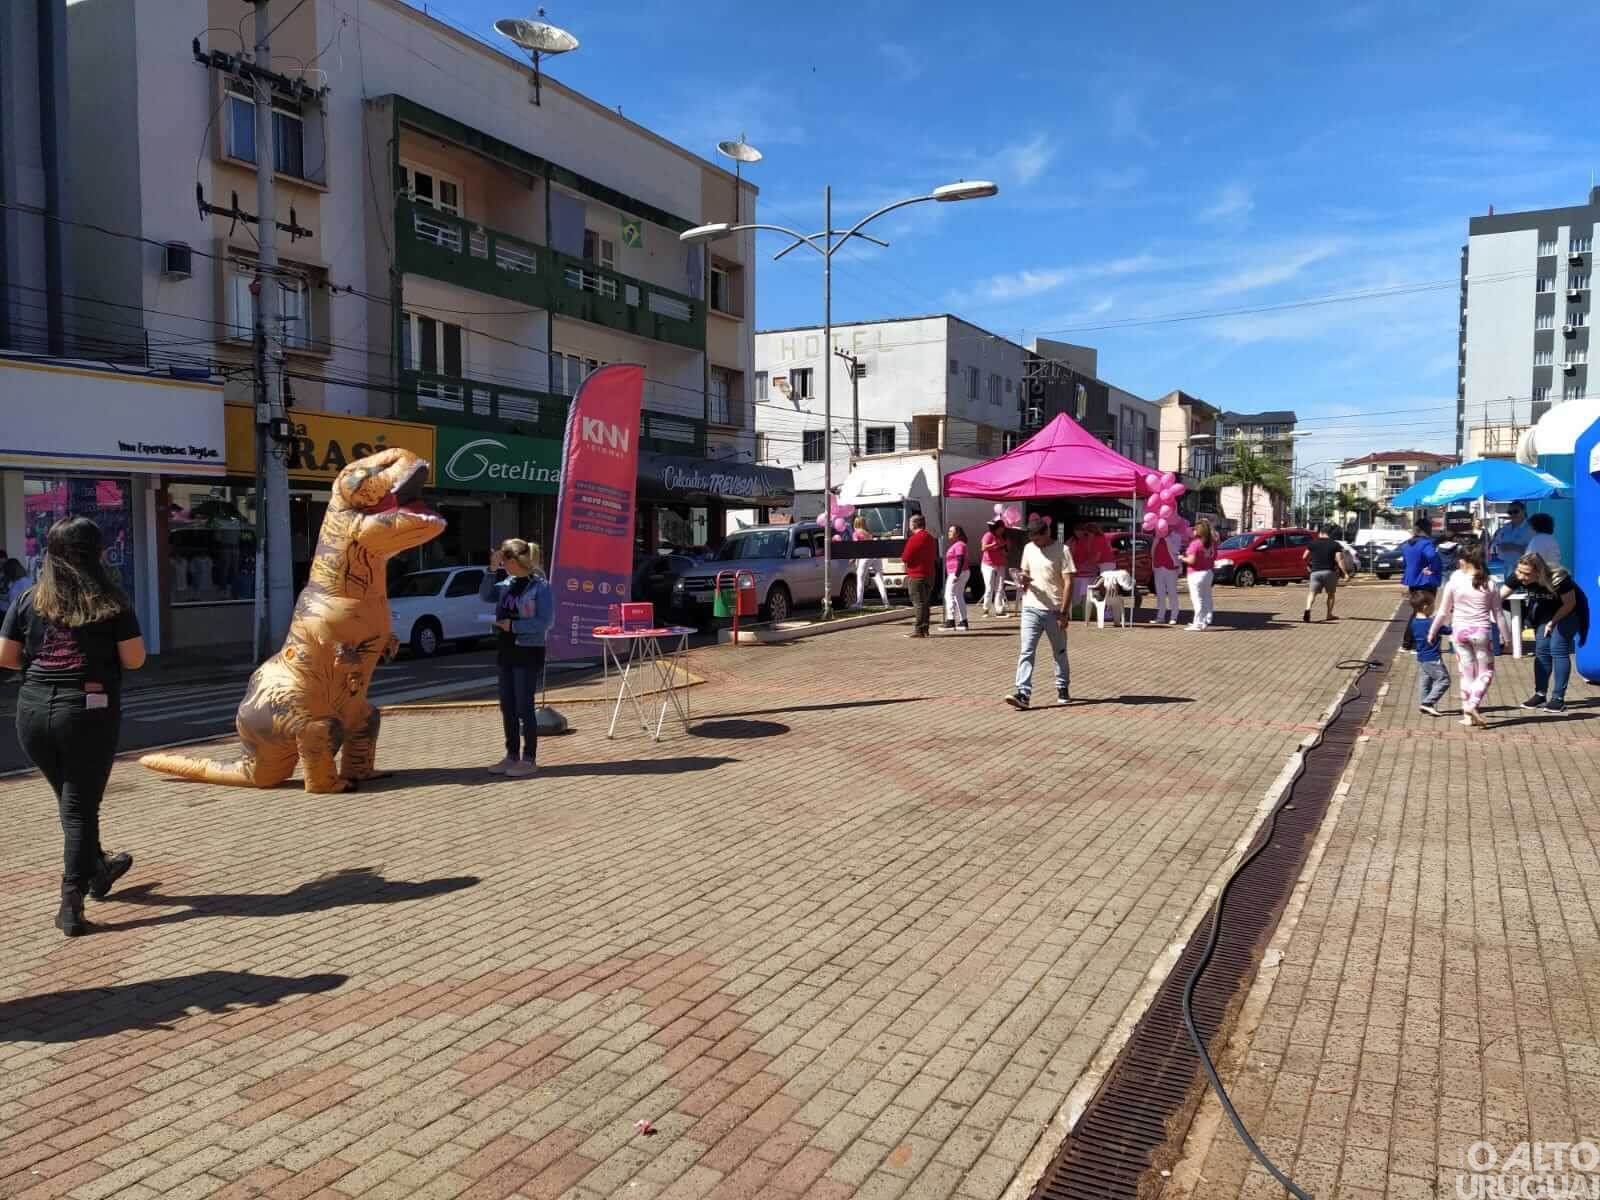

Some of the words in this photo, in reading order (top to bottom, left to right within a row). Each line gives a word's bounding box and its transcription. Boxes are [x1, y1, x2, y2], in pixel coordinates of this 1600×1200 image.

[781, 329, 893, 360] HOTEL
[582, 415, 630, 453] KNN
[445, 438, 561, 482] Getelina
